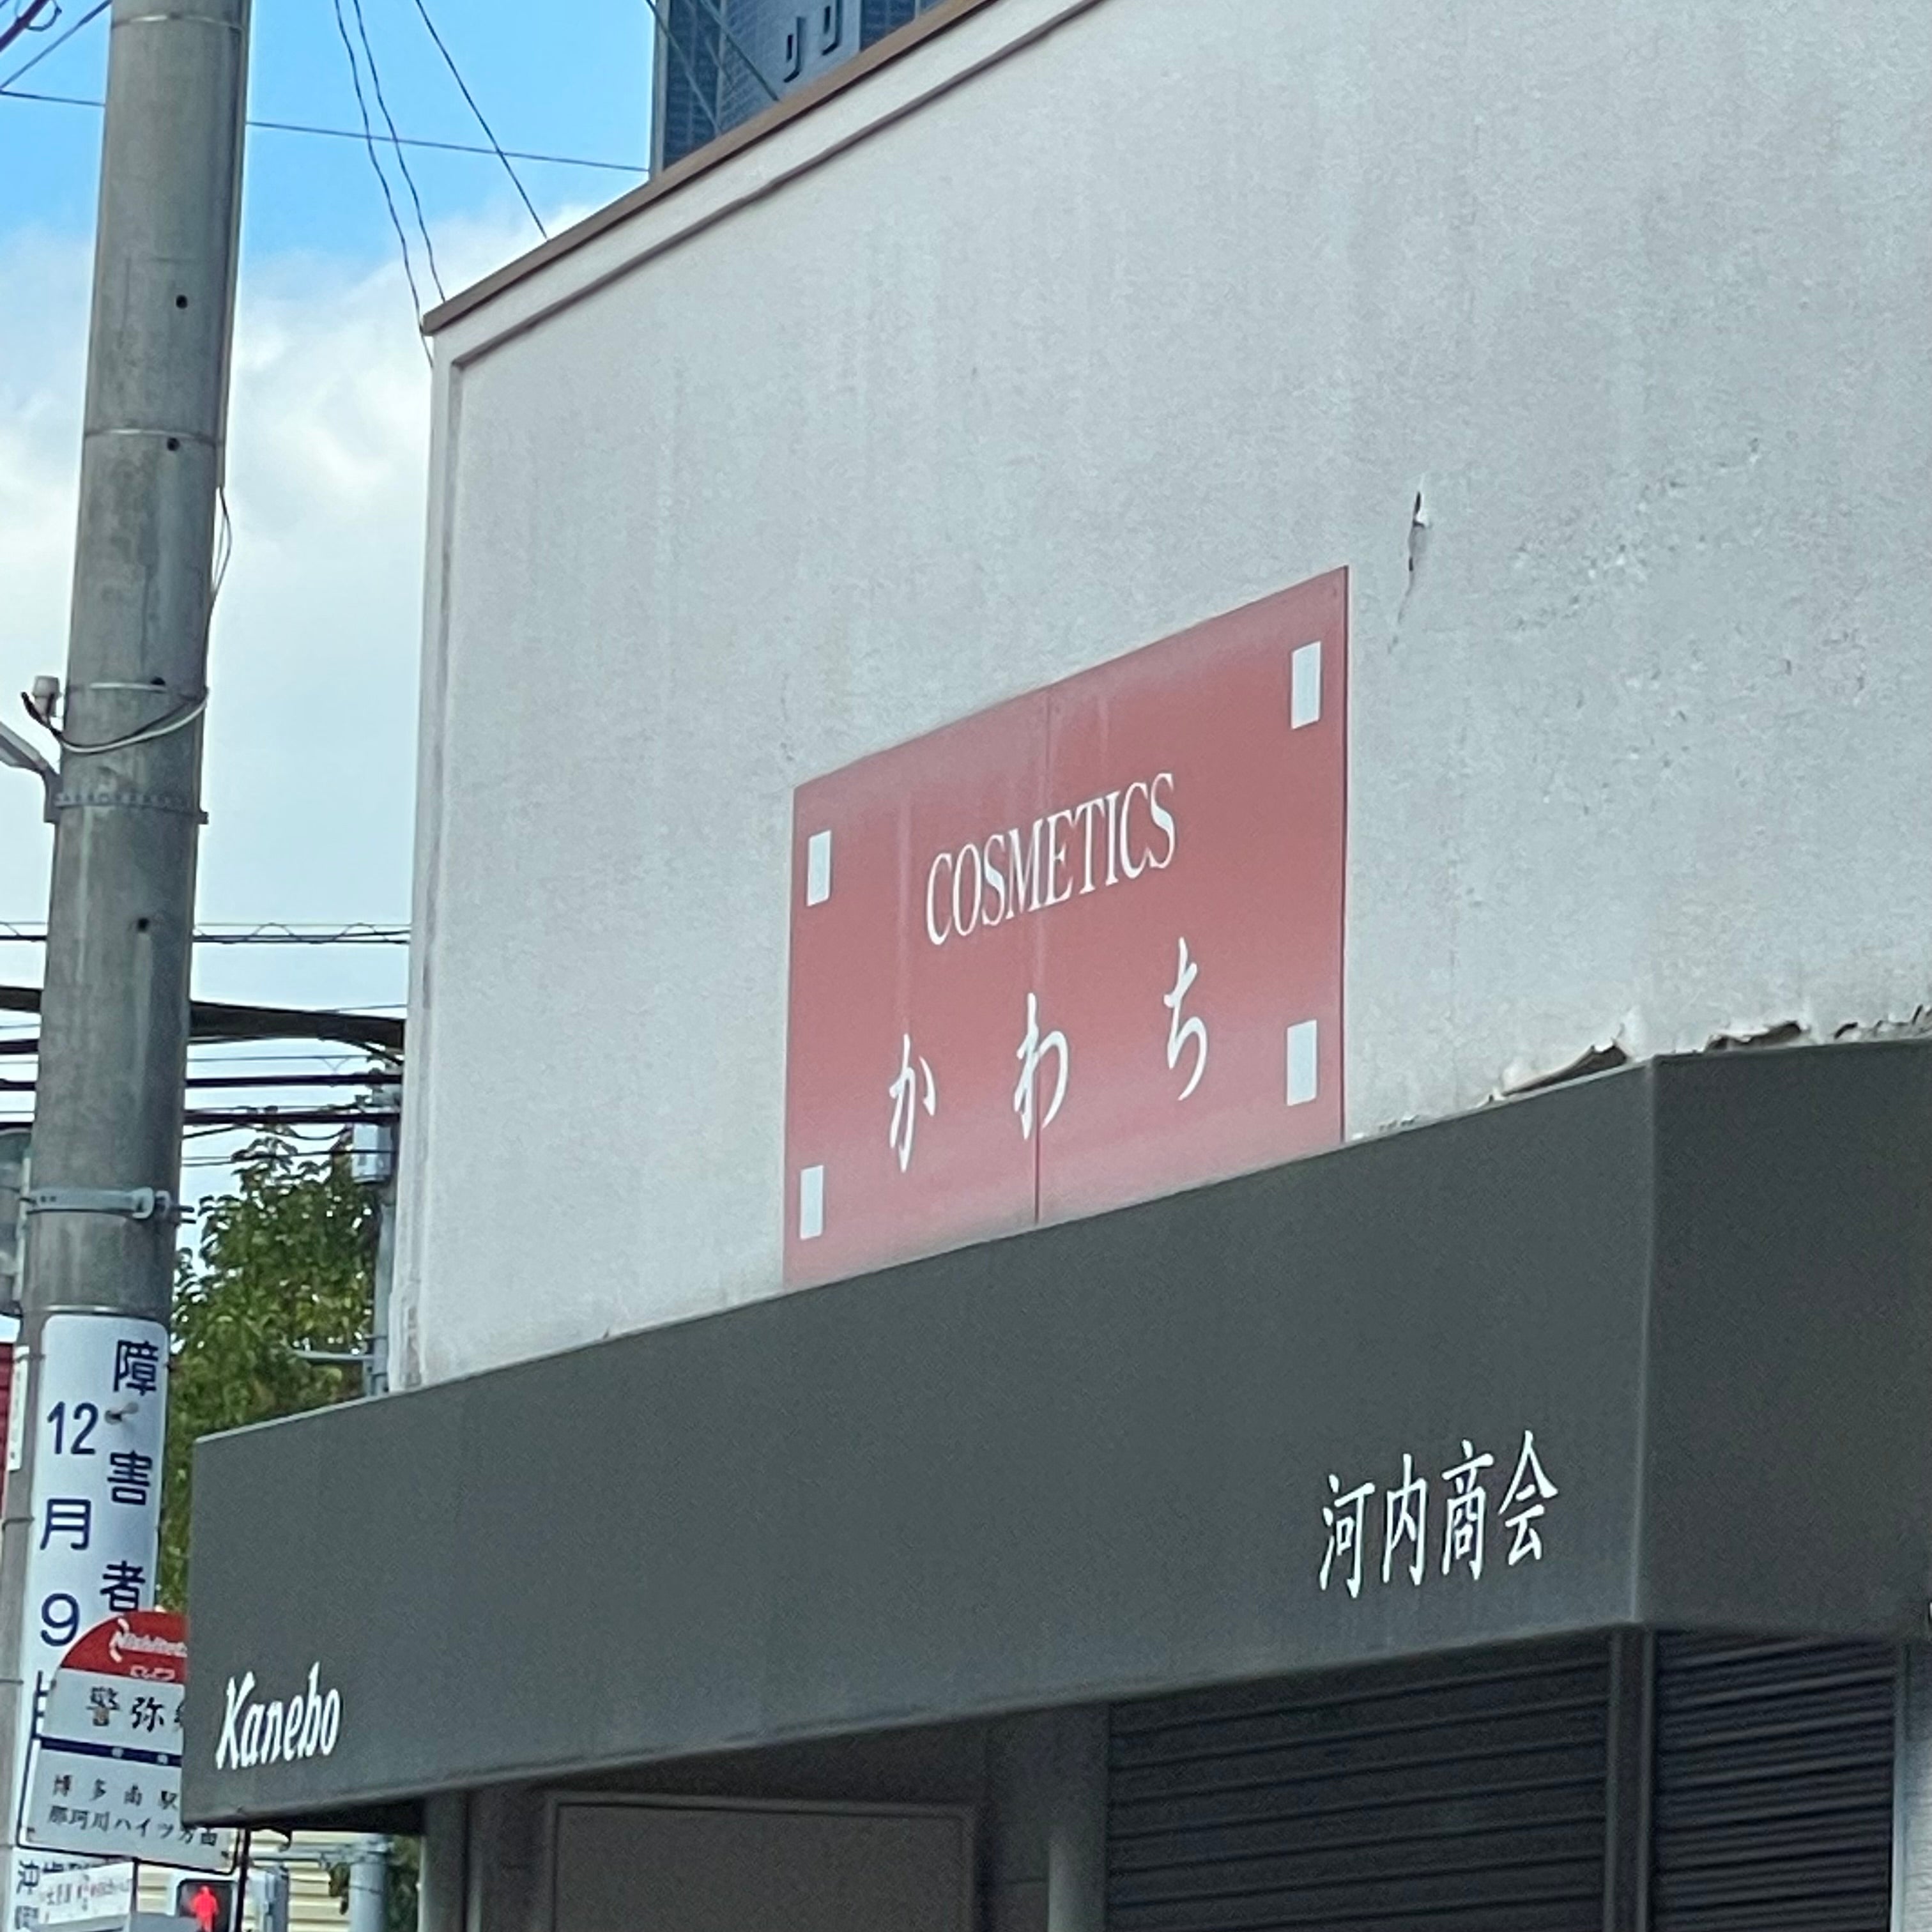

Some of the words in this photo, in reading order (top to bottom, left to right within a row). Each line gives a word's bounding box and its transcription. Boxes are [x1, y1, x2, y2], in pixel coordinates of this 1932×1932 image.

[926, 772, 1177, 946] COSMETICS
[889, 936, 1208, 1173] かわち
[100, 1339, 159, 1613] 障害者
[1319, 1430, 1558, 1598] 河内商会
[36, 1400, 99, 1739] 12月9
[86, 1685, 183, 1732] 警弥
[215, 1661, 342, 1770] Kanebo
